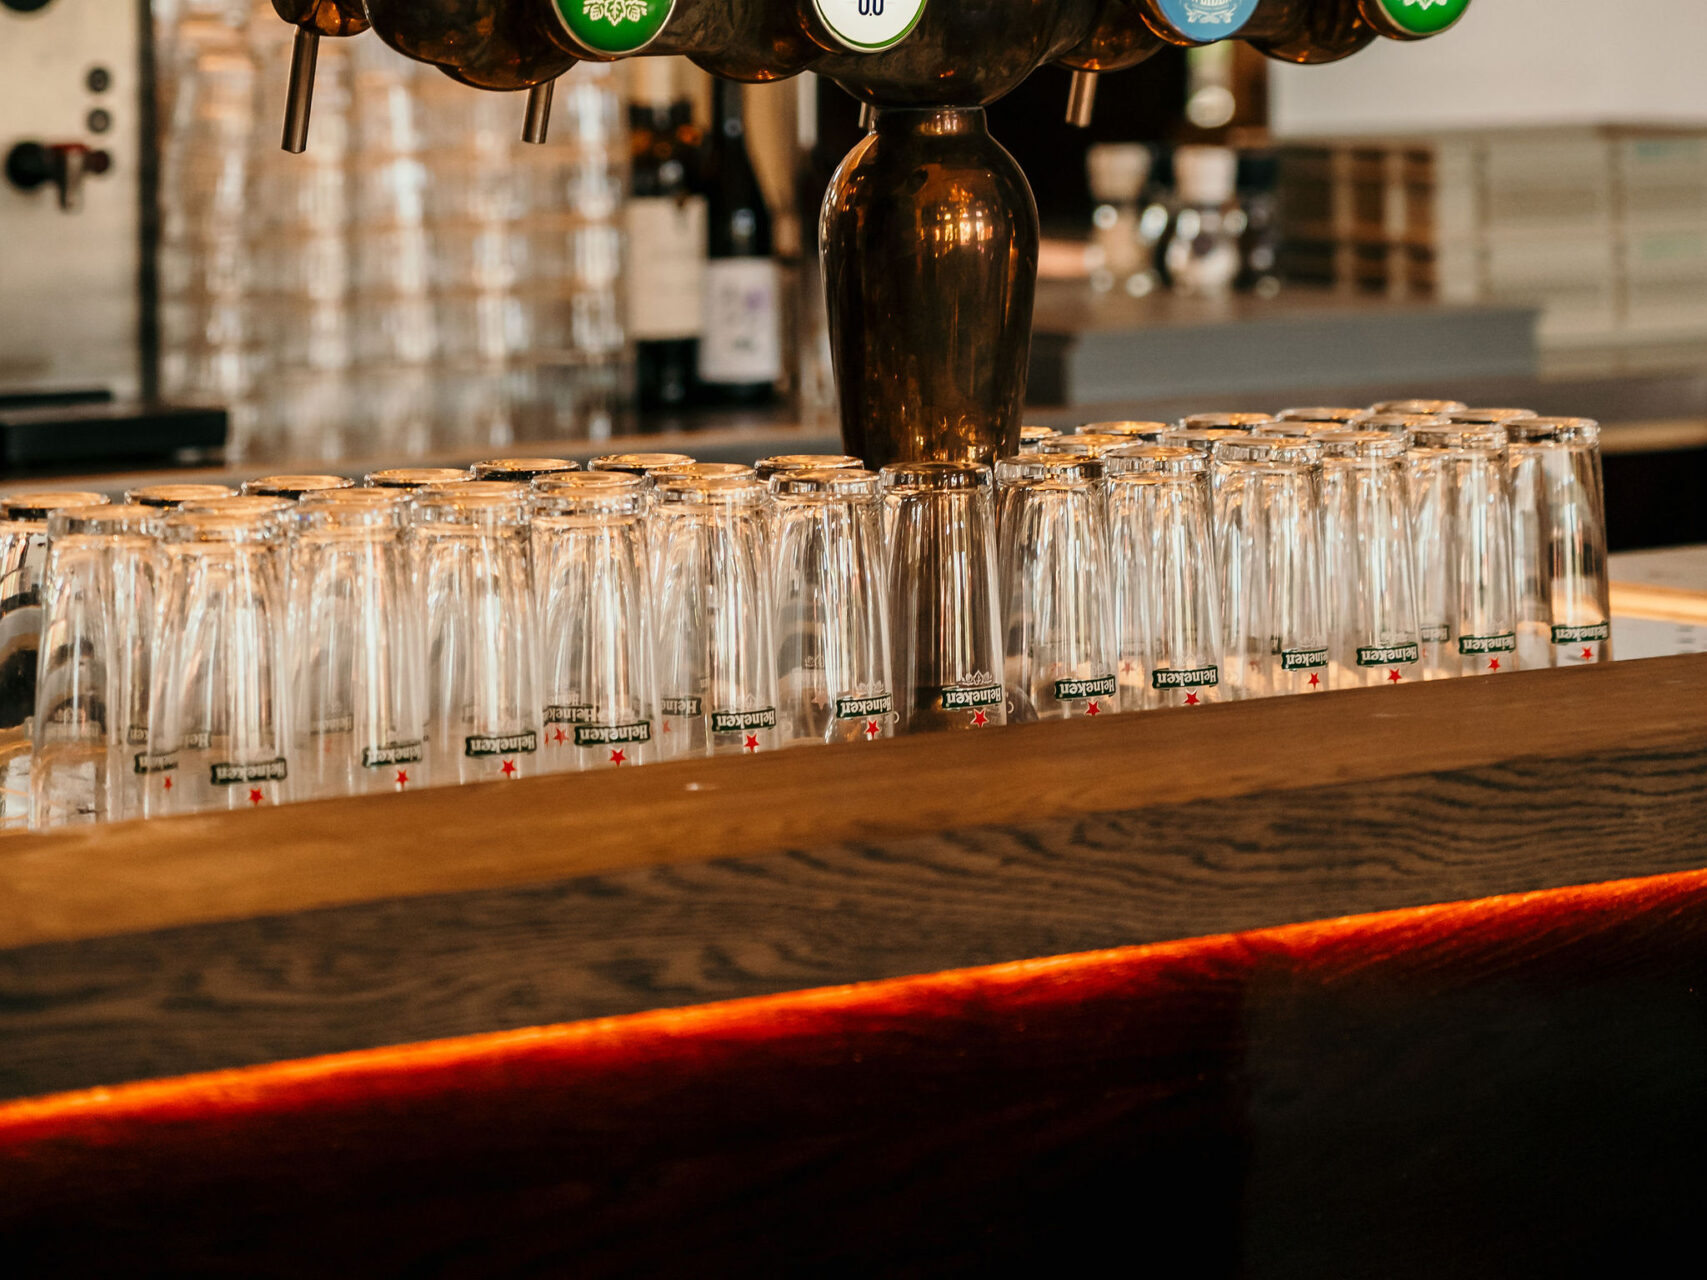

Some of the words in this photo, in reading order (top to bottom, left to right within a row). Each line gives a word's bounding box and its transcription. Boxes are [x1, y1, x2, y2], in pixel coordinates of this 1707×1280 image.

[1463, 635, 1515, 653] Heineken
[1285, 652, 1328, 667] eineken
[1361, 645, 1417, 664] Heineken
[1059, 677, 1115, 696] Heineken
[1157, 668, 1217, 687] Heineken
[945, 685, 1002, 705] Heineken
[841, 695, 892, 715] Heineken
[716, 710, 776, 729] Heineken
[579, 724, 649, 742] Heineken
[471, 734, 535, 754] Heineken
